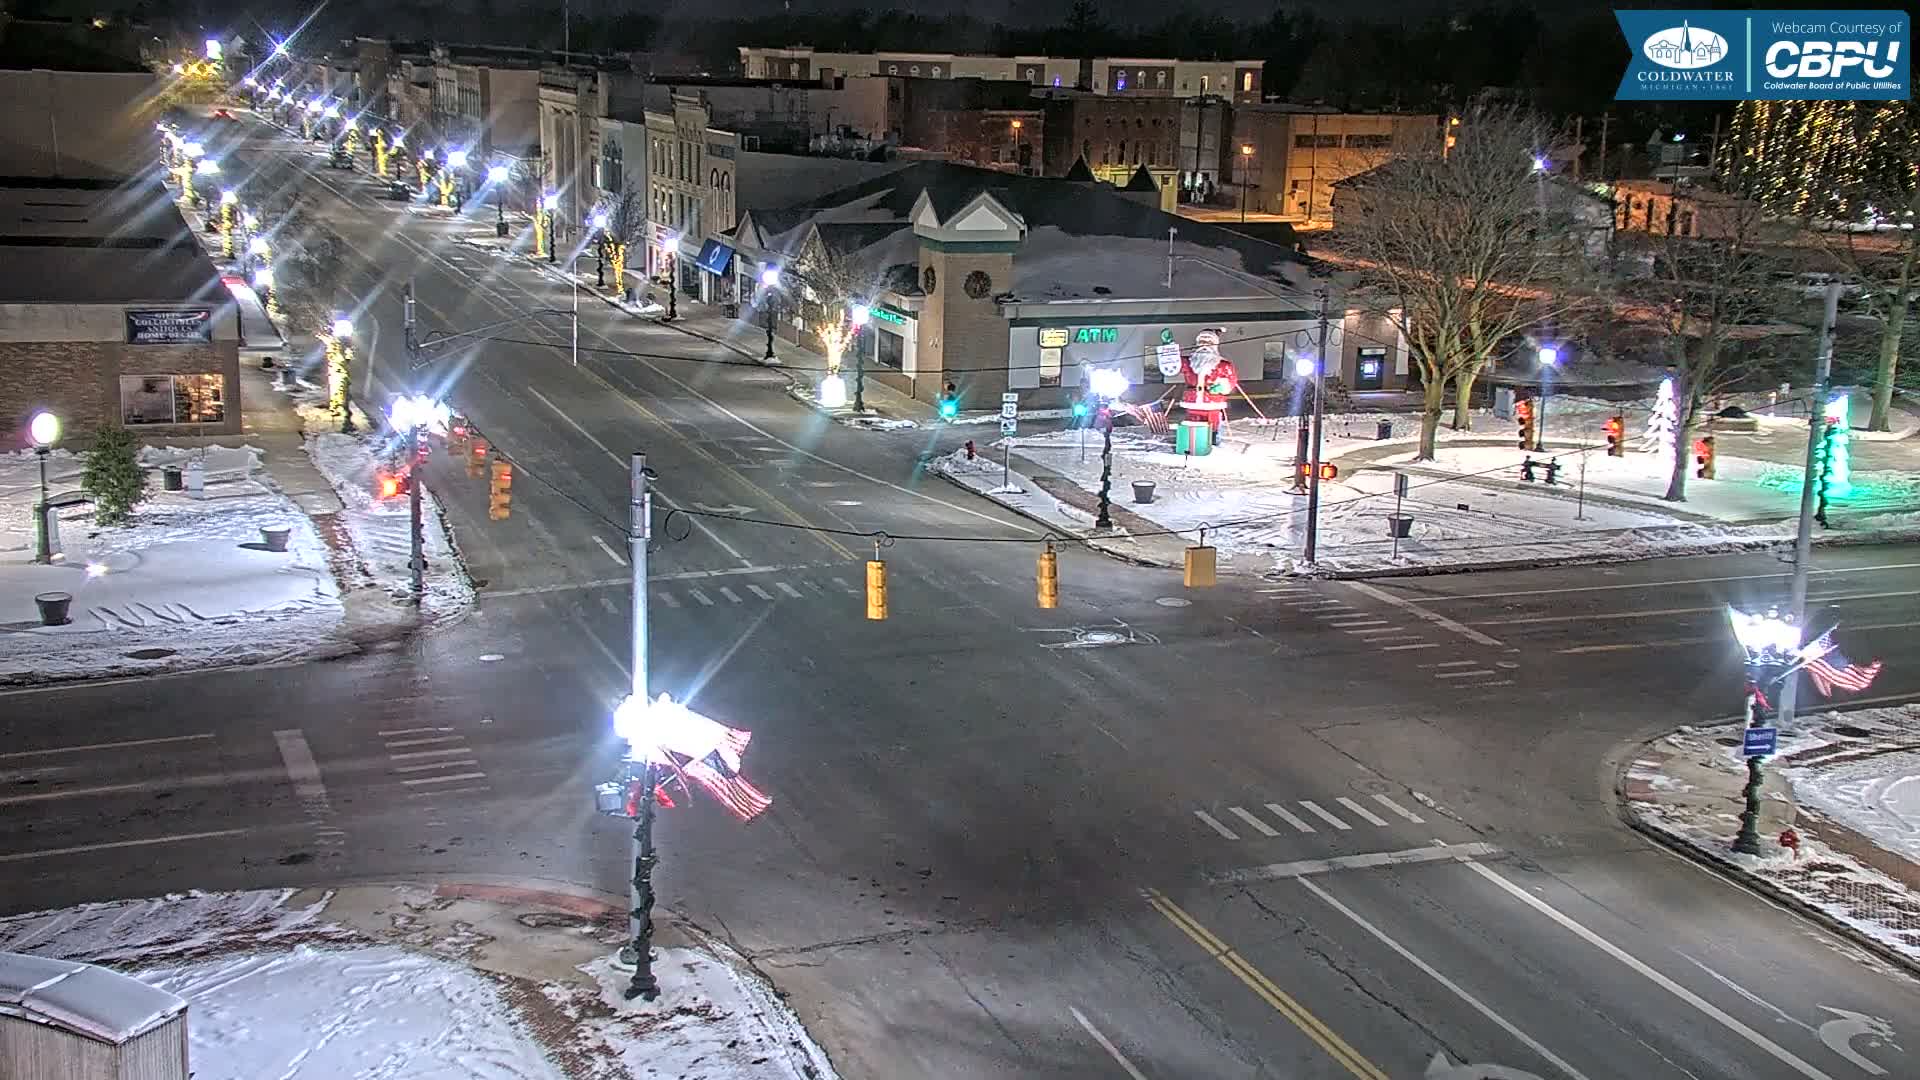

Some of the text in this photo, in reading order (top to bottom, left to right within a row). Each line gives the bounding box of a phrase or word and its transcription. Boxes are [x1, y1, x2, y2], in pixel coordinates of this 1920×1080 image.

[147, 325, 193, 333] ANTIQUES
[1076, 328, 1119, 343] ATM
[1004, 405, 1014, 415] 12
